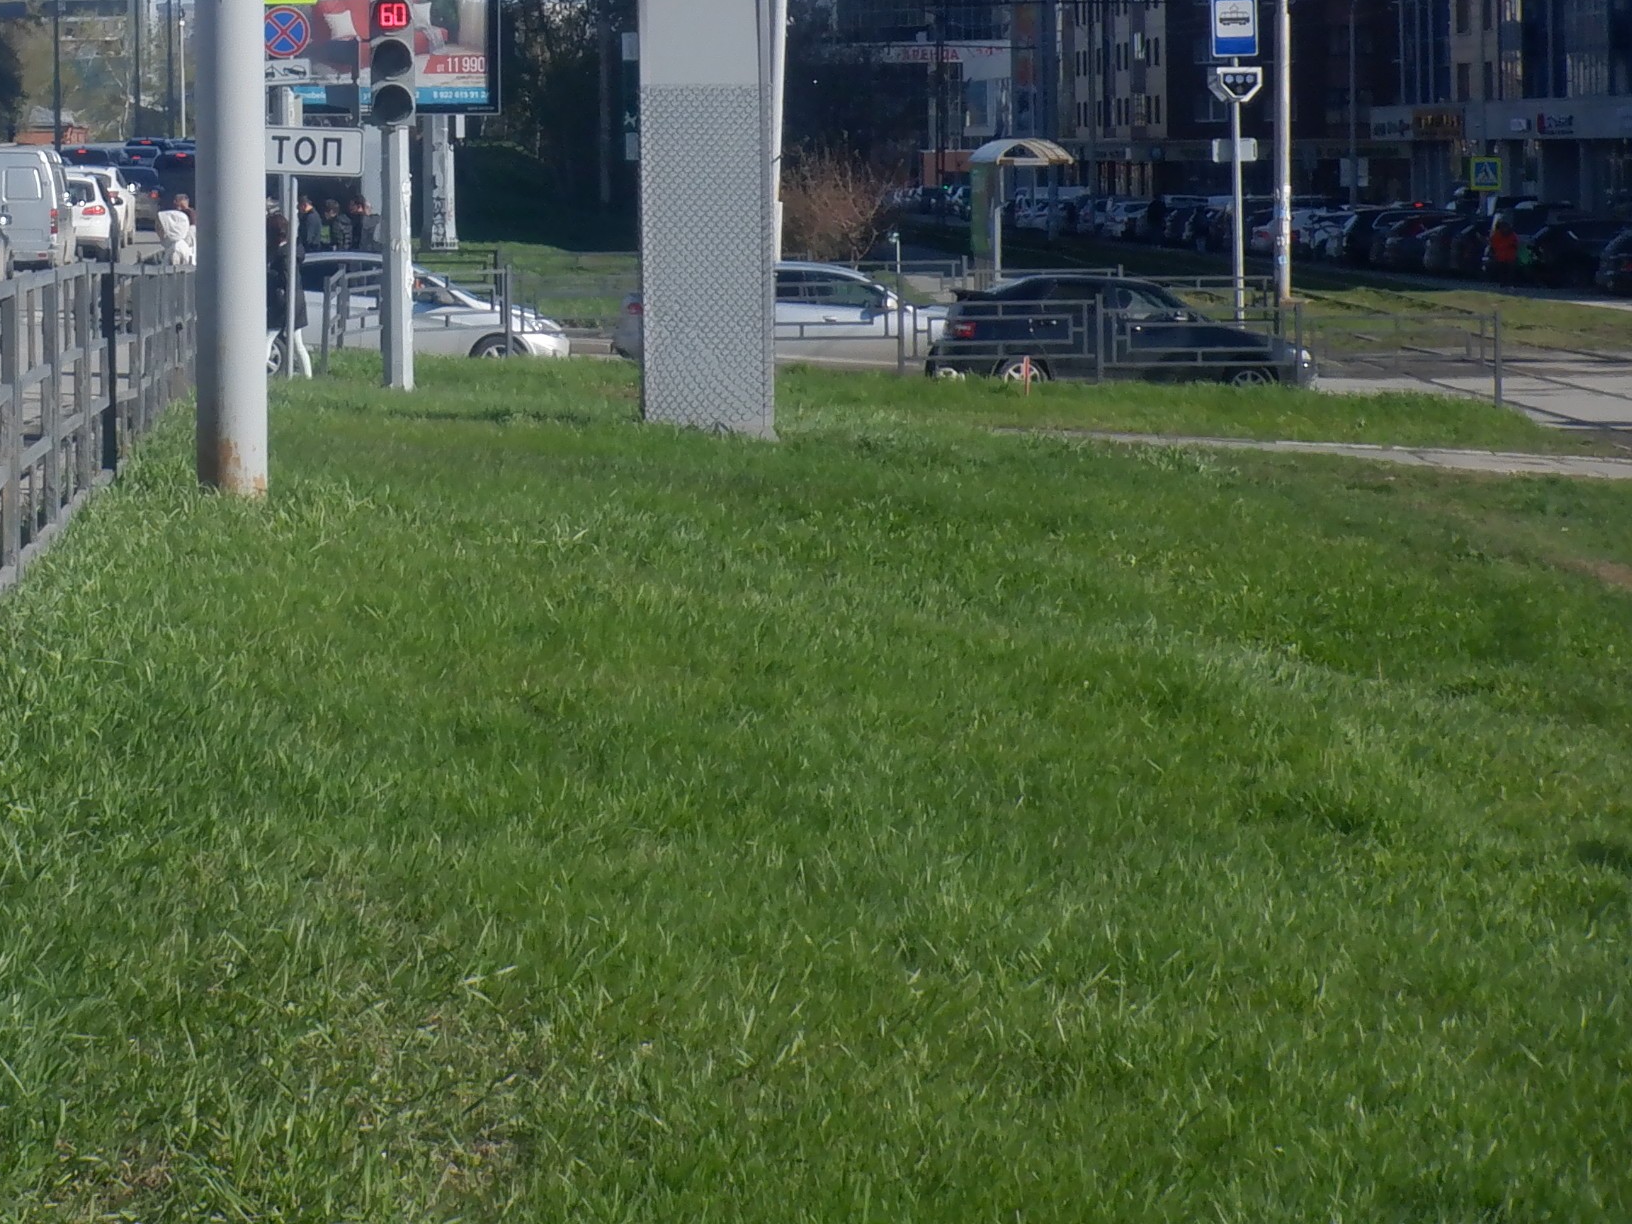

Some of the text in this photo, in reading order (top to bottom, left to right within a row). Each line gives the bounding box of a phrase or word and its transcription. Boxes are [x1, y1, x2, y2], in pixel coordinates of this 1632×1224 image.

[380, 3, 407, 27] 60
[447, 57, 459, 73] 11
[462, 56, 486, 73] 990
[271, 135, 342, 166] ТОП
